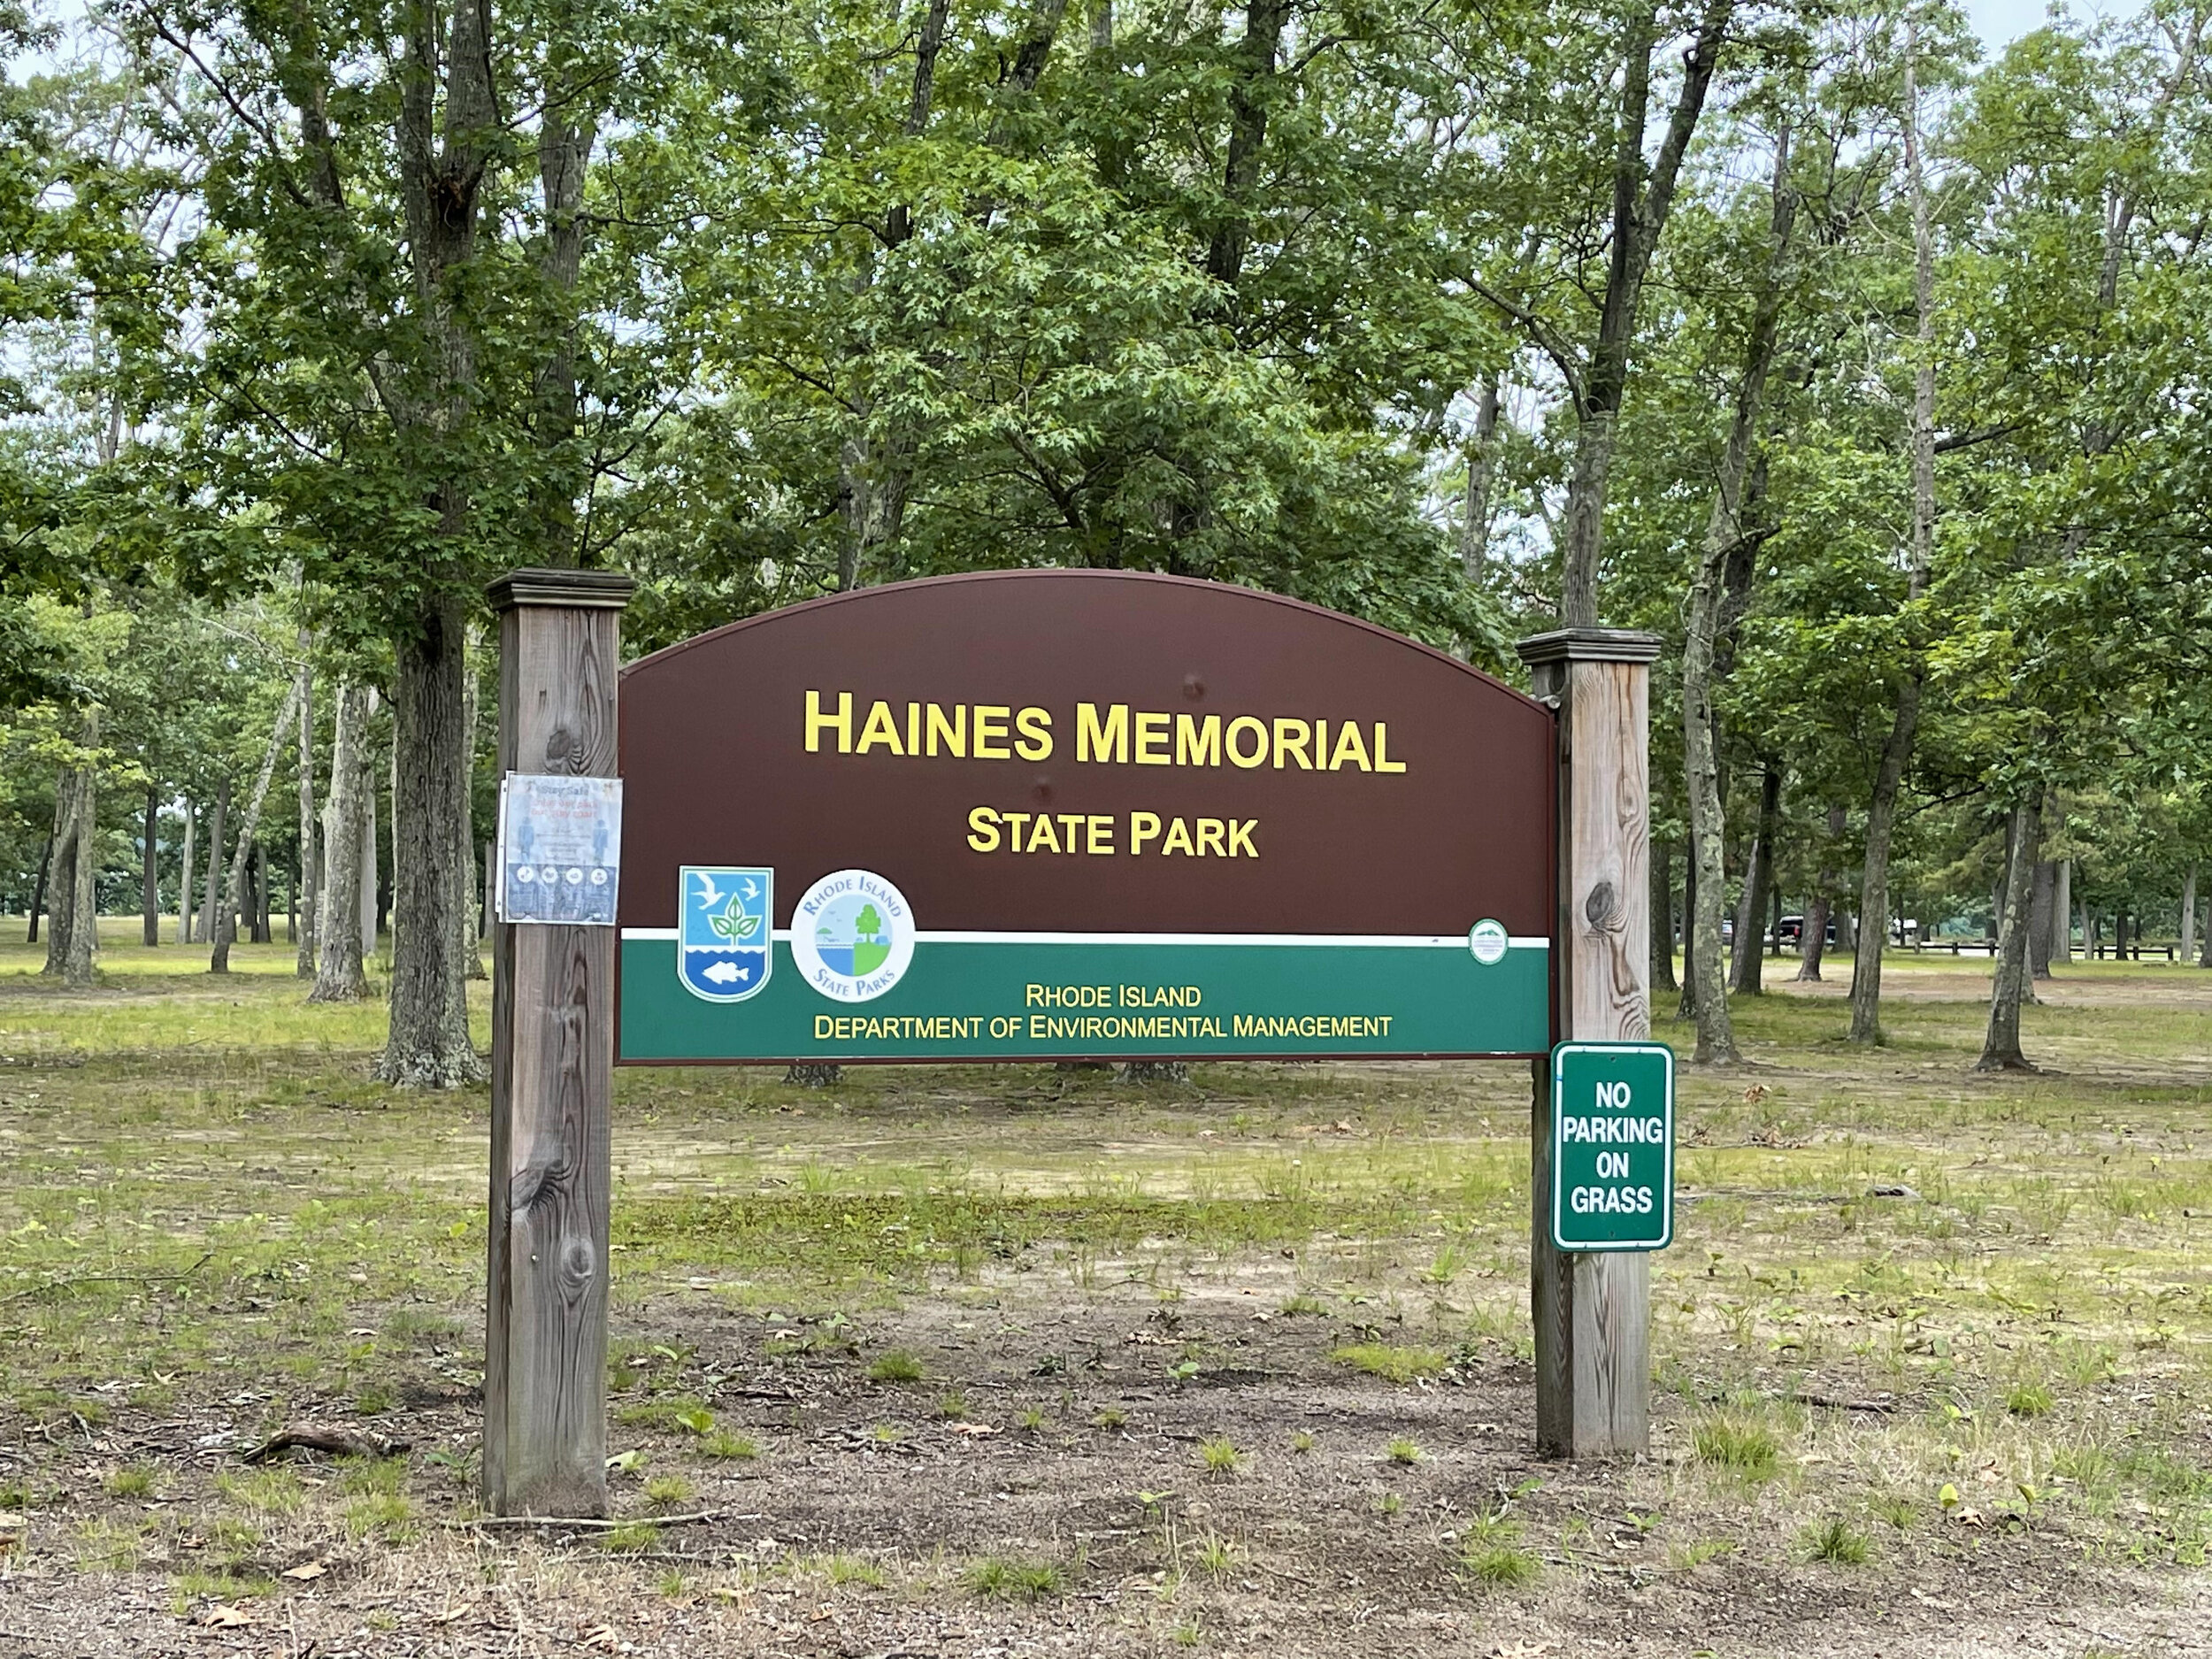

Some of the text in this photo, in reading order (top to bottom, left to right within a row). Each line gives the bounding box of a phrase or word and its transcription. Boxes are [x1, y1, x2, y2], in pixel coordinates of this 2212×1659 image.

[805, 691, 1406, 772] HAINES MEMORIAL
[968, 807, 1258, 856] STATE PARK
[803, 875, 902, 918] RHODE ISLAND
[813, 969, 895, 996] STATE PARKS
[1027, 985, 1201, 1007] RHODE ISLAND
[816, 1016, 1392, 1038] DEPARTMENT OF ENVIRONMENTAL MANAGEMENT
[1597, 1082, 1630, 1108] NO
[1563, 1118, 1663, 1143] PARKING
[1597, 1152, 1628, 1178] ON
[1571, 1187, 1652, 1212] GRASS
